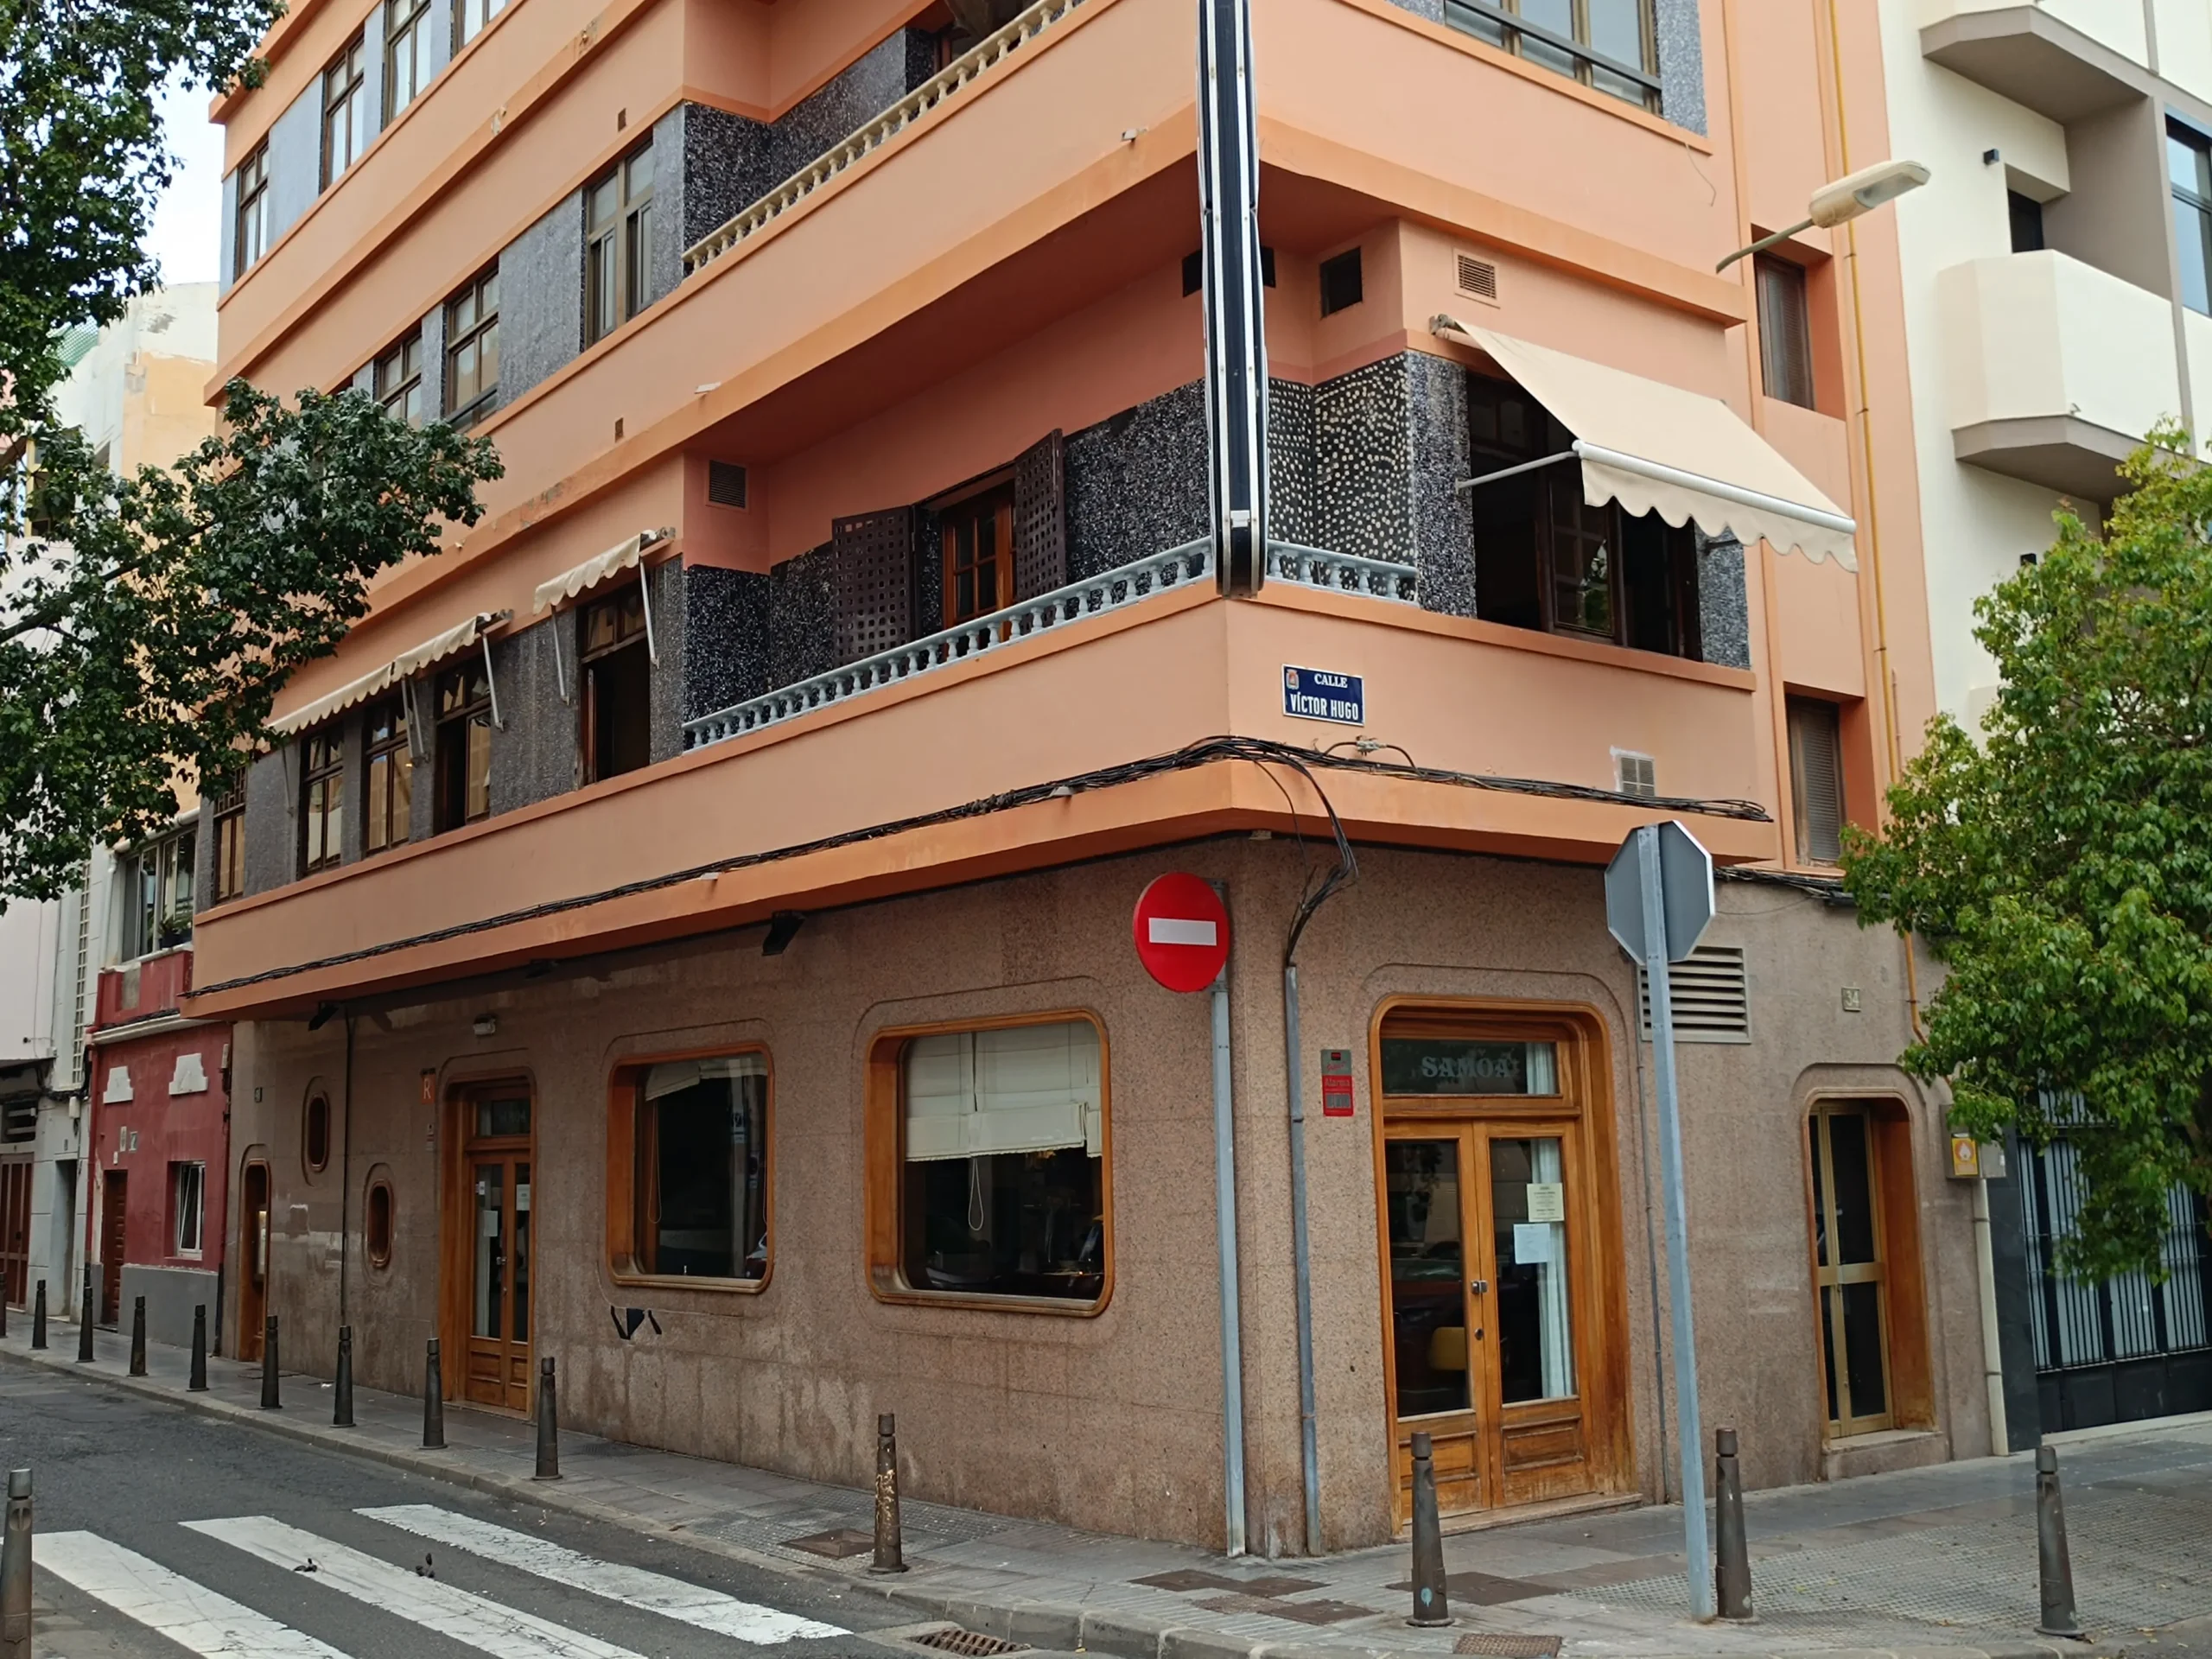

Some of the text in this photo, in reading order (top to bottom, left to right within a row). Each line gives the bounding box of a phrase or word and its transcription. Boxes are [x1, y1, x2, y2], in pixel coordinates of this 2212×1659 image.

[1314, 674, 1348, 688] CALLE
[1290, 691, 1358, 721] VÍCTOR HUGO
[1845, 990, 1859, 1007] 34
[1421, 1056, 1511, 1077] SAMOA
[423, 1077, 431, 1099] R
